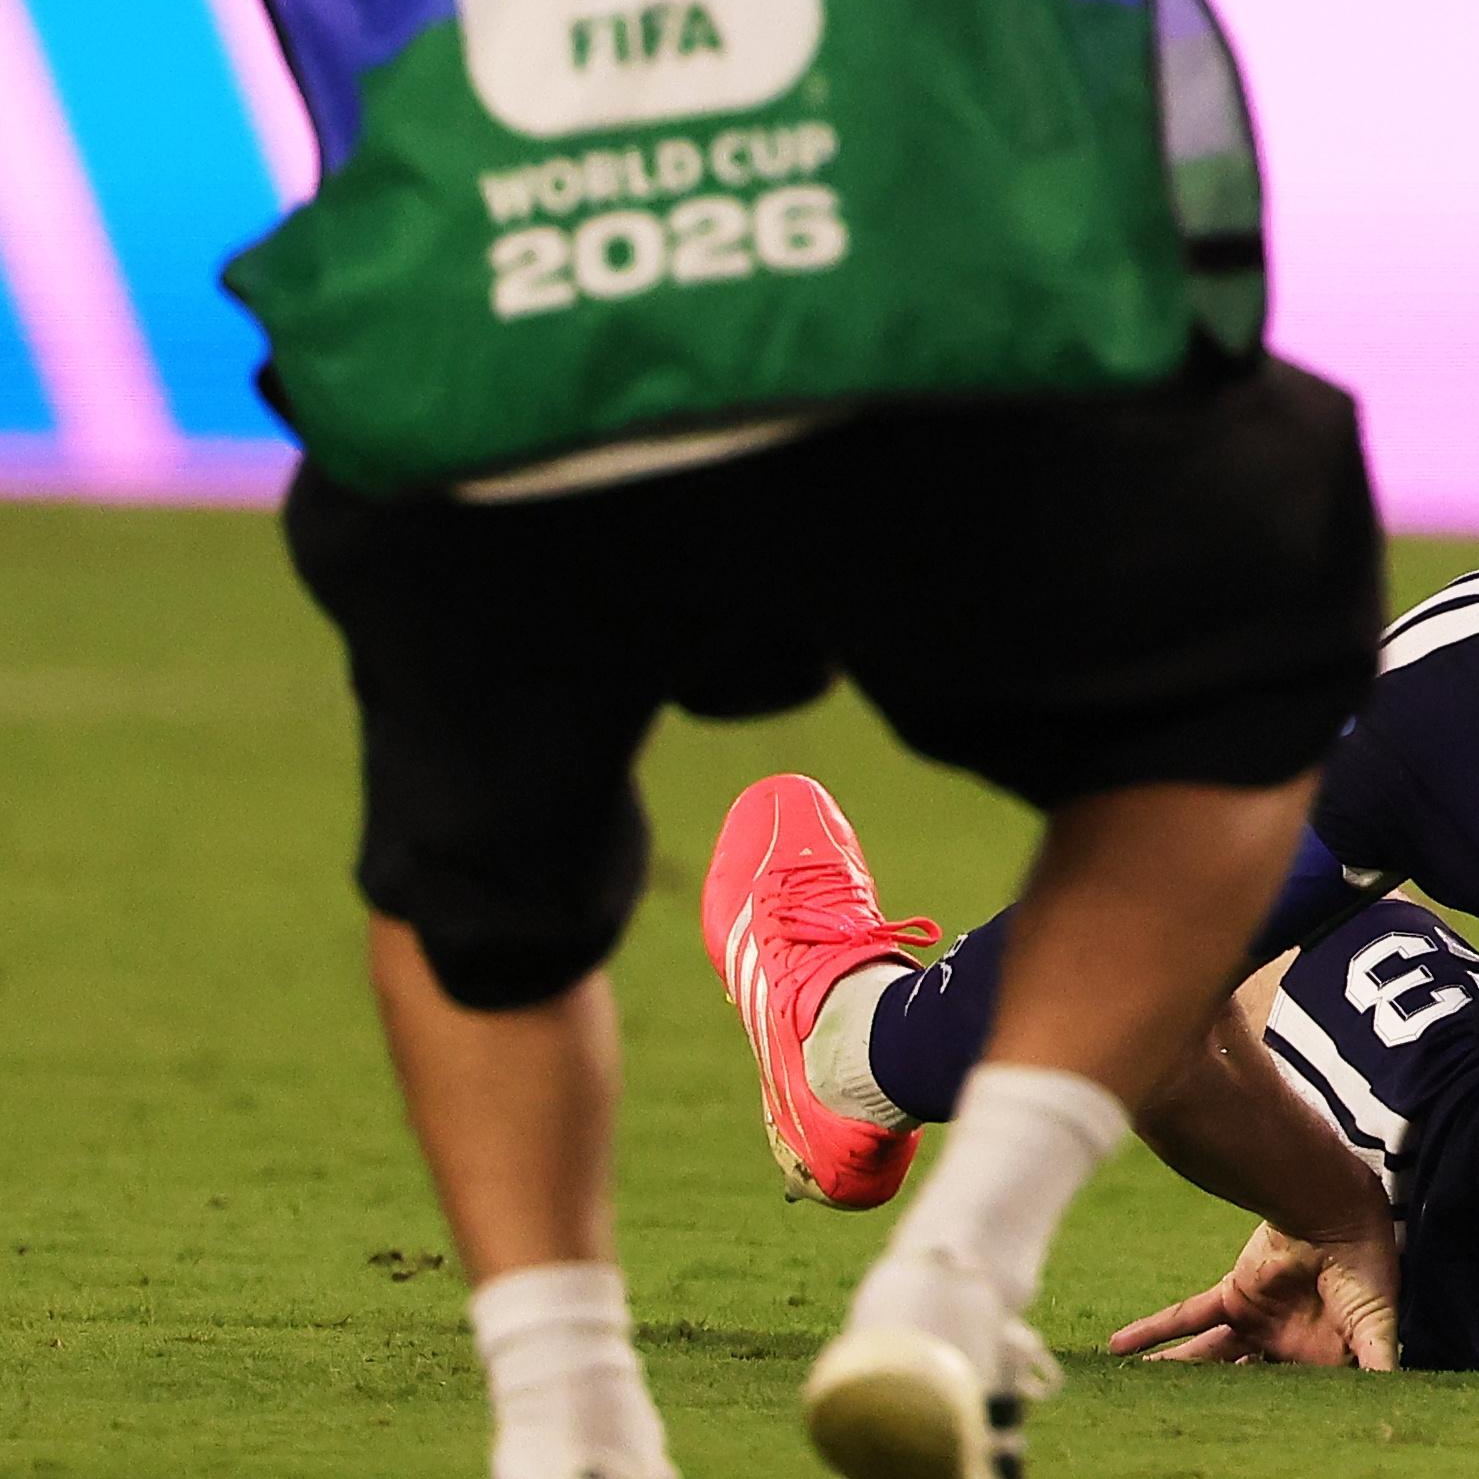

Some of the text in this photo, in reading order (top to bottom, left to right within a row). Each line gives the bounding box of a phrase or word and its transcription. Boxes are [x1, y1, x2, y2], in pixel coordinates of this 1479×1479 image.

[571, 1, 722, 71] FIFA
[482, 121, 838, 222] WORLD CUP
[489, 184, 849, 319] 2026
